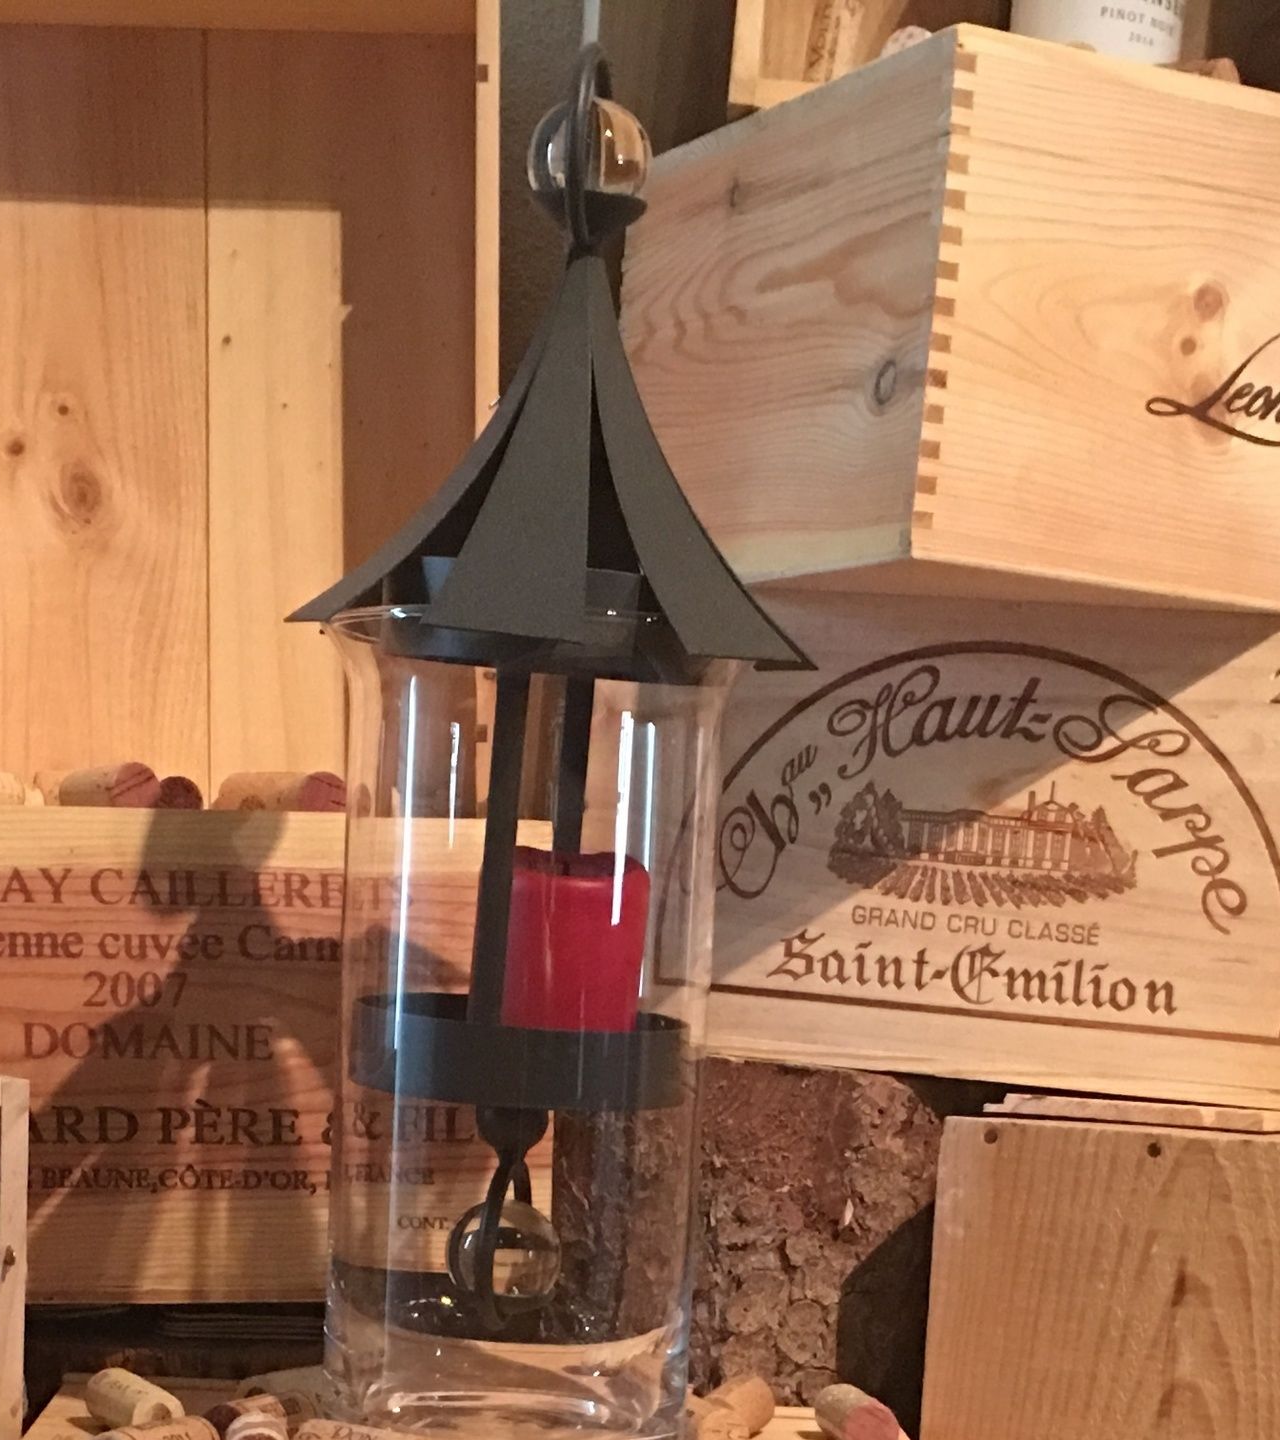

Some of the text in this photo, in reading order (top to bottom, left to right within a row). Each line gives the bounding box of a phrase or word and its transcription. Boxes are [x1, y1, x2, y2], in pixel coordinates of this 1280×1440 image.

[850, 903, 1101, 946] GRAND CRU CLASSÉ
[81, 970, 188, 1009] 2007
[22, 1021, 274, 1062] DOMAINE
[27, 1104, 140, 1145] ARD
[157, 1097, 304, 1146] PÈRE
[397, 1104, 477, 1143] FIL
